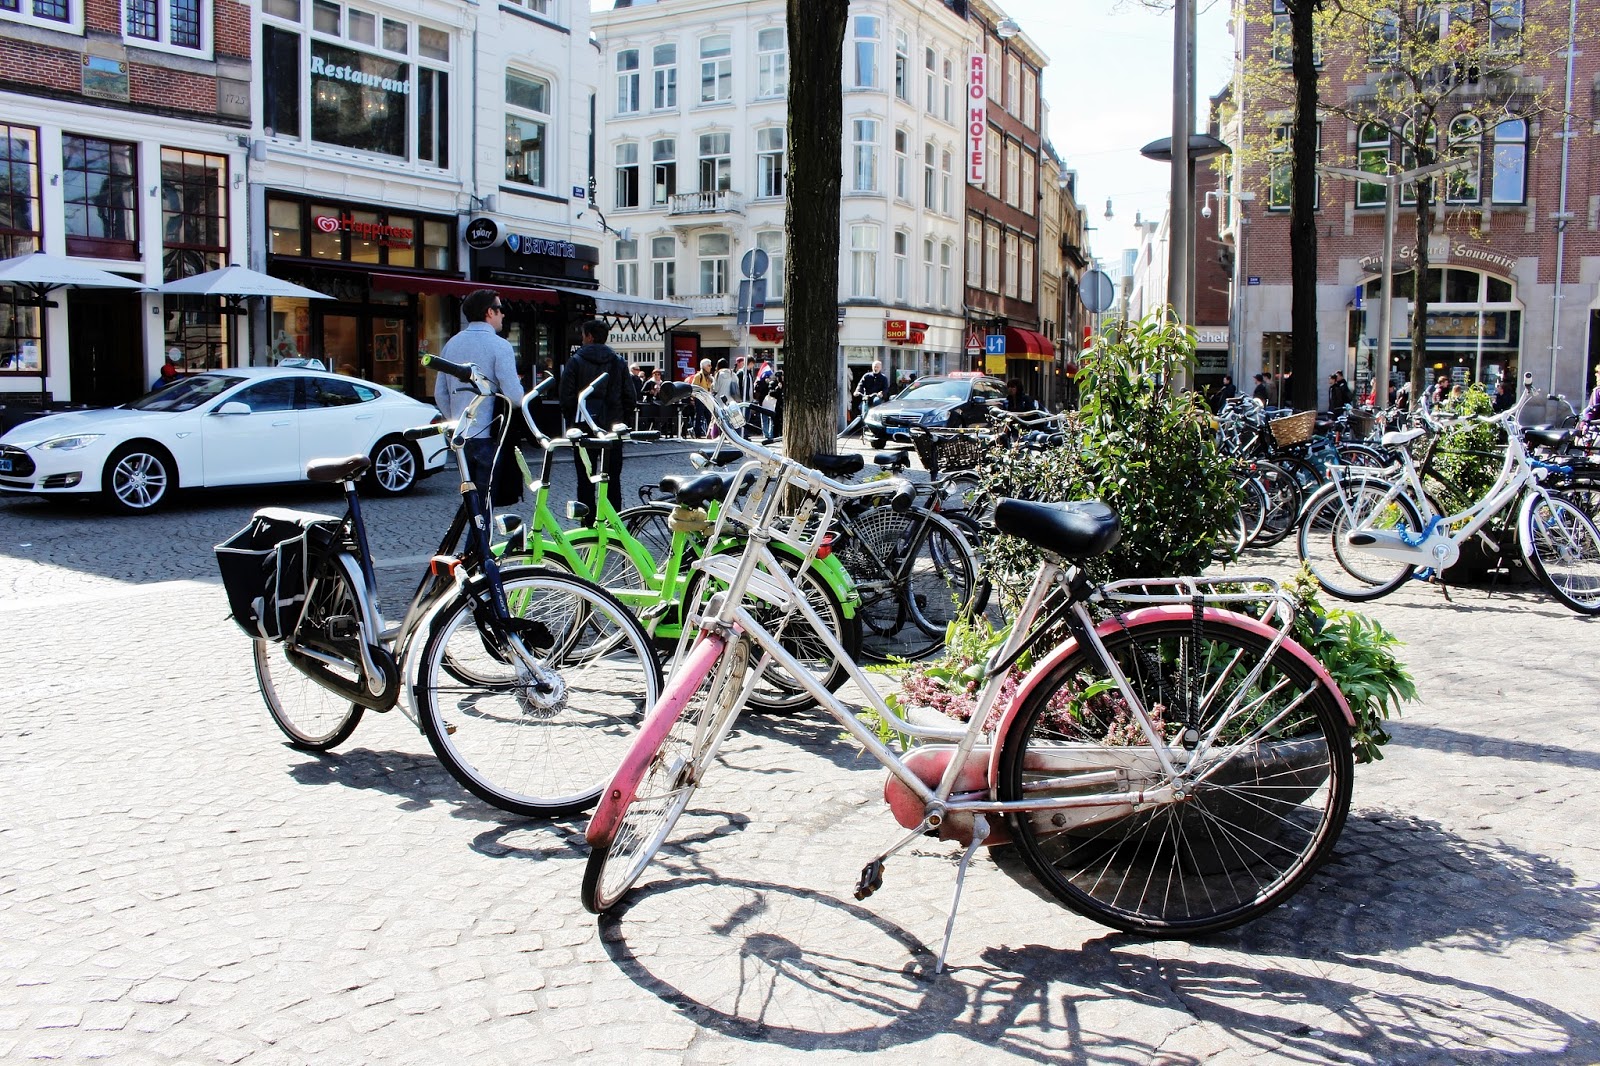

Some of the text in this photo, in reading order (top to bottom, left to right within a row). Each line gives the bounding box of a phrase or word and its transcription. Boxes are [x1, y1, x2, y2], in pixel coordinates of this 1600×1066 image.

[310, 56, 410, 95] Restaurant
[225, 94, 246, 105] 1725
[970, 57, 984, 180] RHO HOTEL
[341, 213, 413, 240] Happiness
[522, 236, 575, 259] Bavaria
[1455, 244, 1517, 269] Souvenirs
